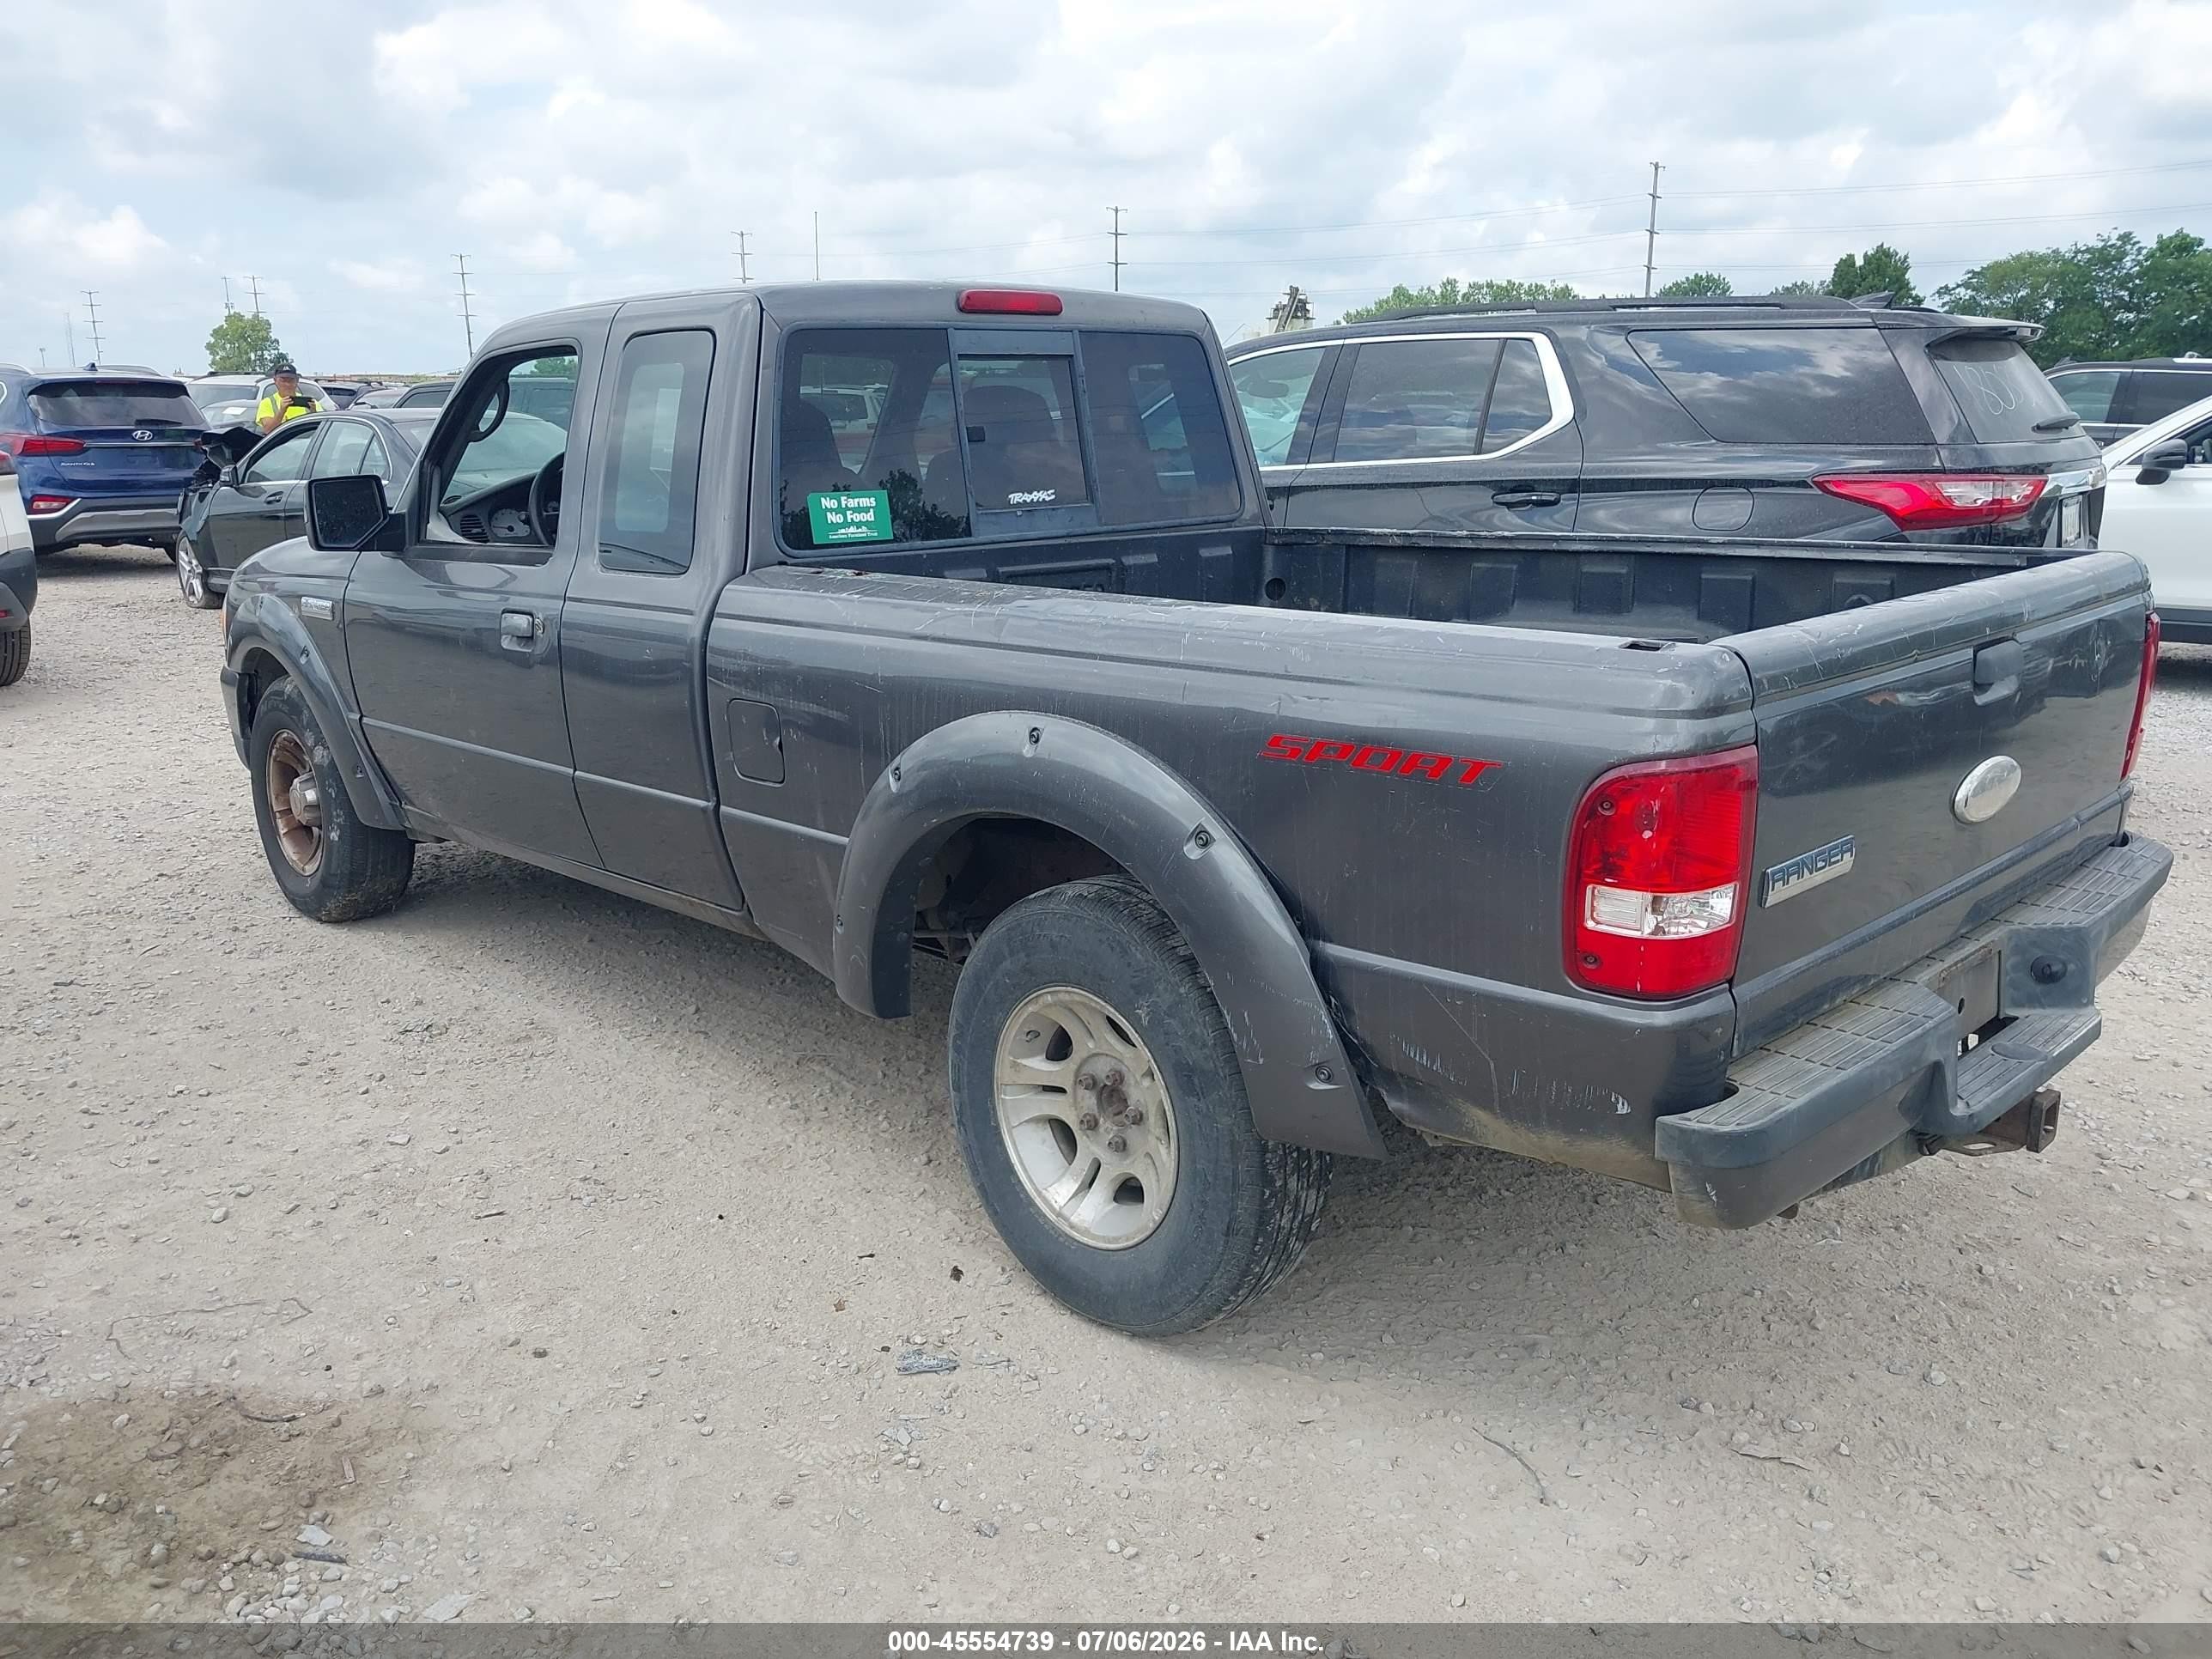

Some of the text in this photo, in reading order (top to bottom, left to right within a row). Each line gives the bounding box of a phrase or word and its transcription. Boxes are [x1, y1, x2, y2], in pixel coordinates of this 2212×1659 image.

[820, 495, 876, 509] No Farms
[1008, 489, 1055, 505] TRAXXAS
[826, 508, 875, 524] No Food
[1260, 732, 1504, 785] SPORT
[1769, 838, 1855, 893] RANGER
